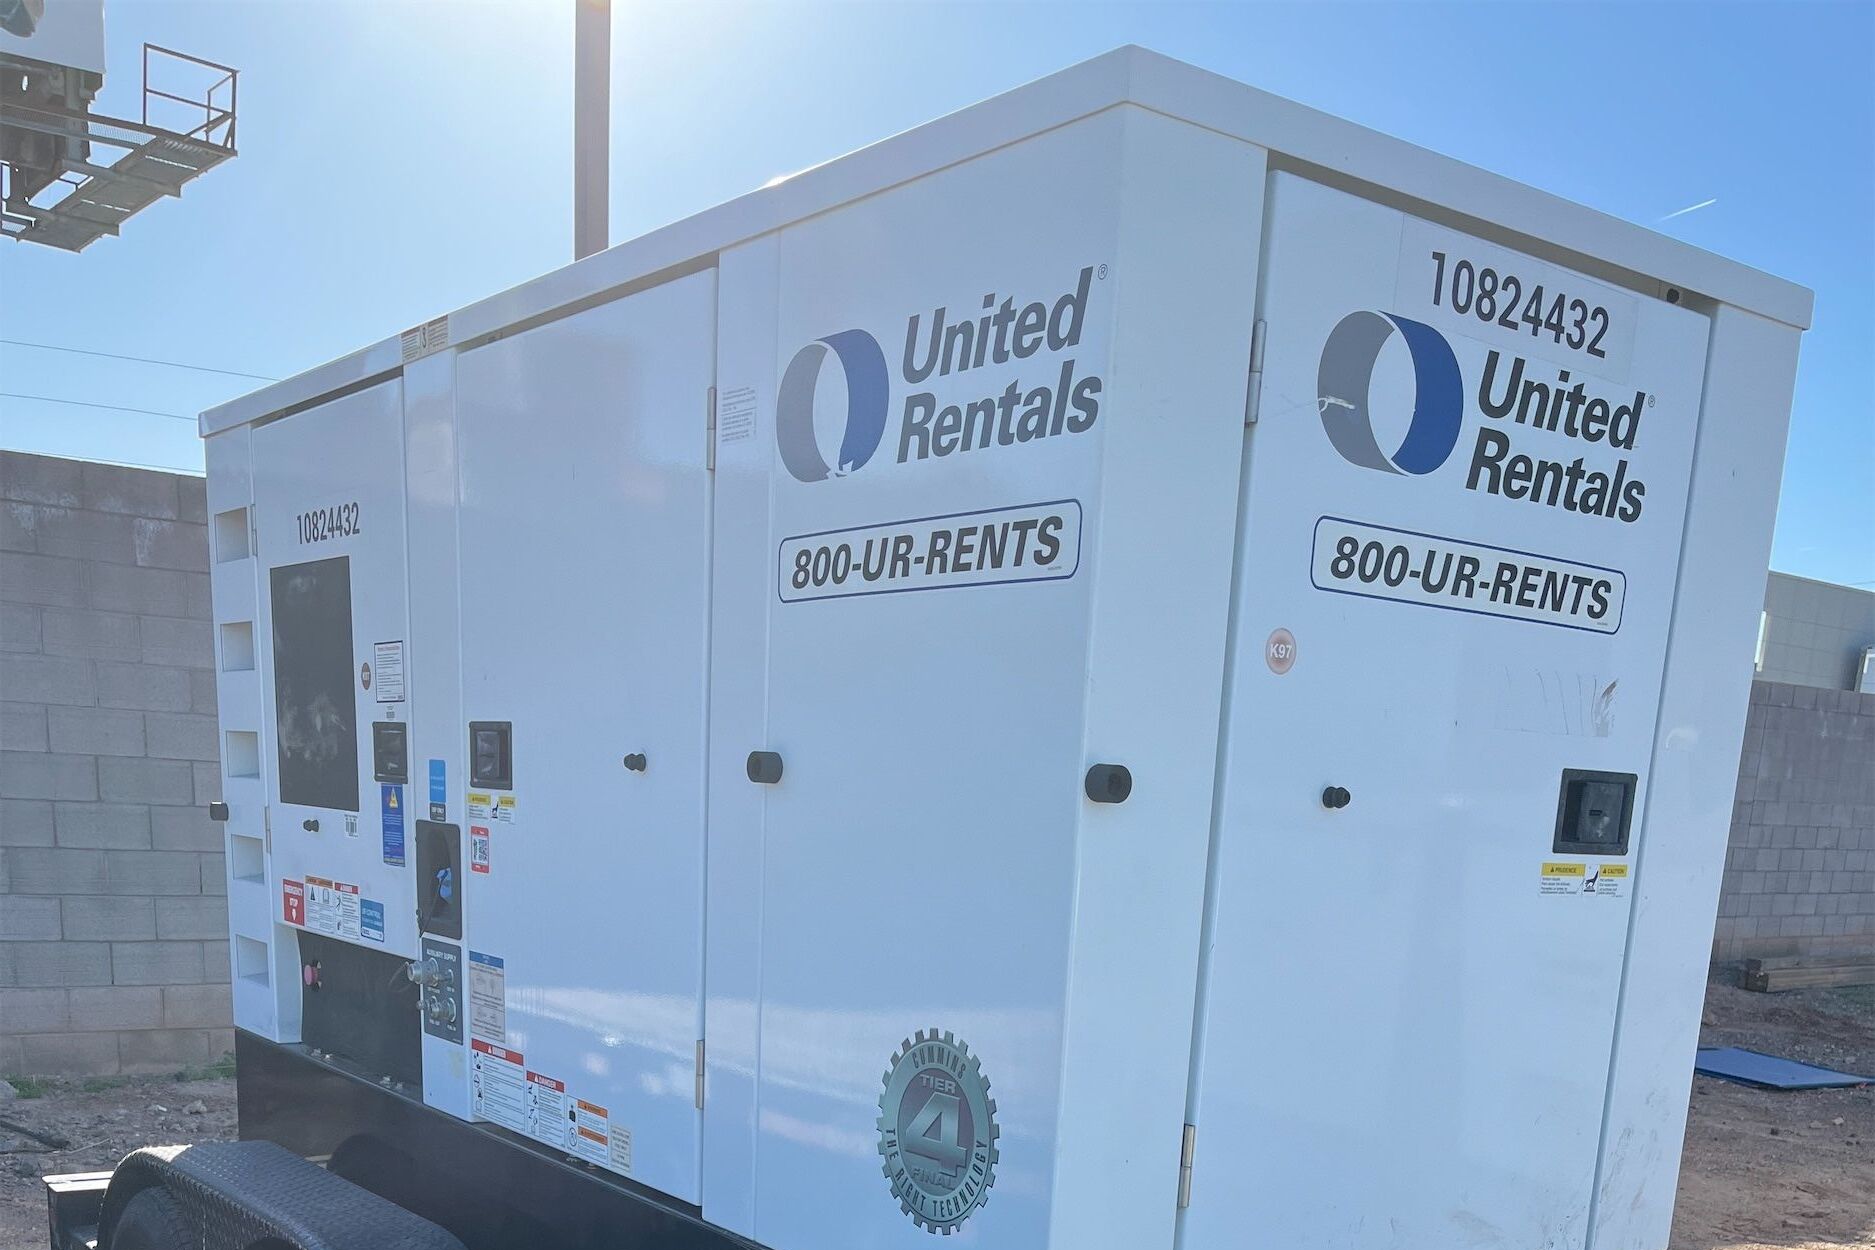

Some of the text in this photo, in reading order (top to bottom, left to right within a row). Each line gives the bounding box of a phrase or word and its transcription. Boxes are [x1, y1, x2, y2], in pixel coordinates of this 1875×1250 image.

[902, 266, 1094, 384] United
[1431, 250, 1610, 359] 10824432
[897, 359, 1103, 464] Rentals
[1478, 349, 1646, 451] United
[1465, 427, 1646, 524] Rentals
[296, 501, 361, 545] 10824432
[791, 515, 1064, 590] 800-UR-RENTS
[1329, 535, 1613, 620] 800-UR-RENTS
[1270, 643, 1292, 659] K97
[911, 1045, 967, 1080] CUMMINS
[919, 1073, 957, 1096] TIER
[885, 1128, 988, 1218] THE RIGHT TECHNOLOGY
[903, 1091, 967, 1178] 4
